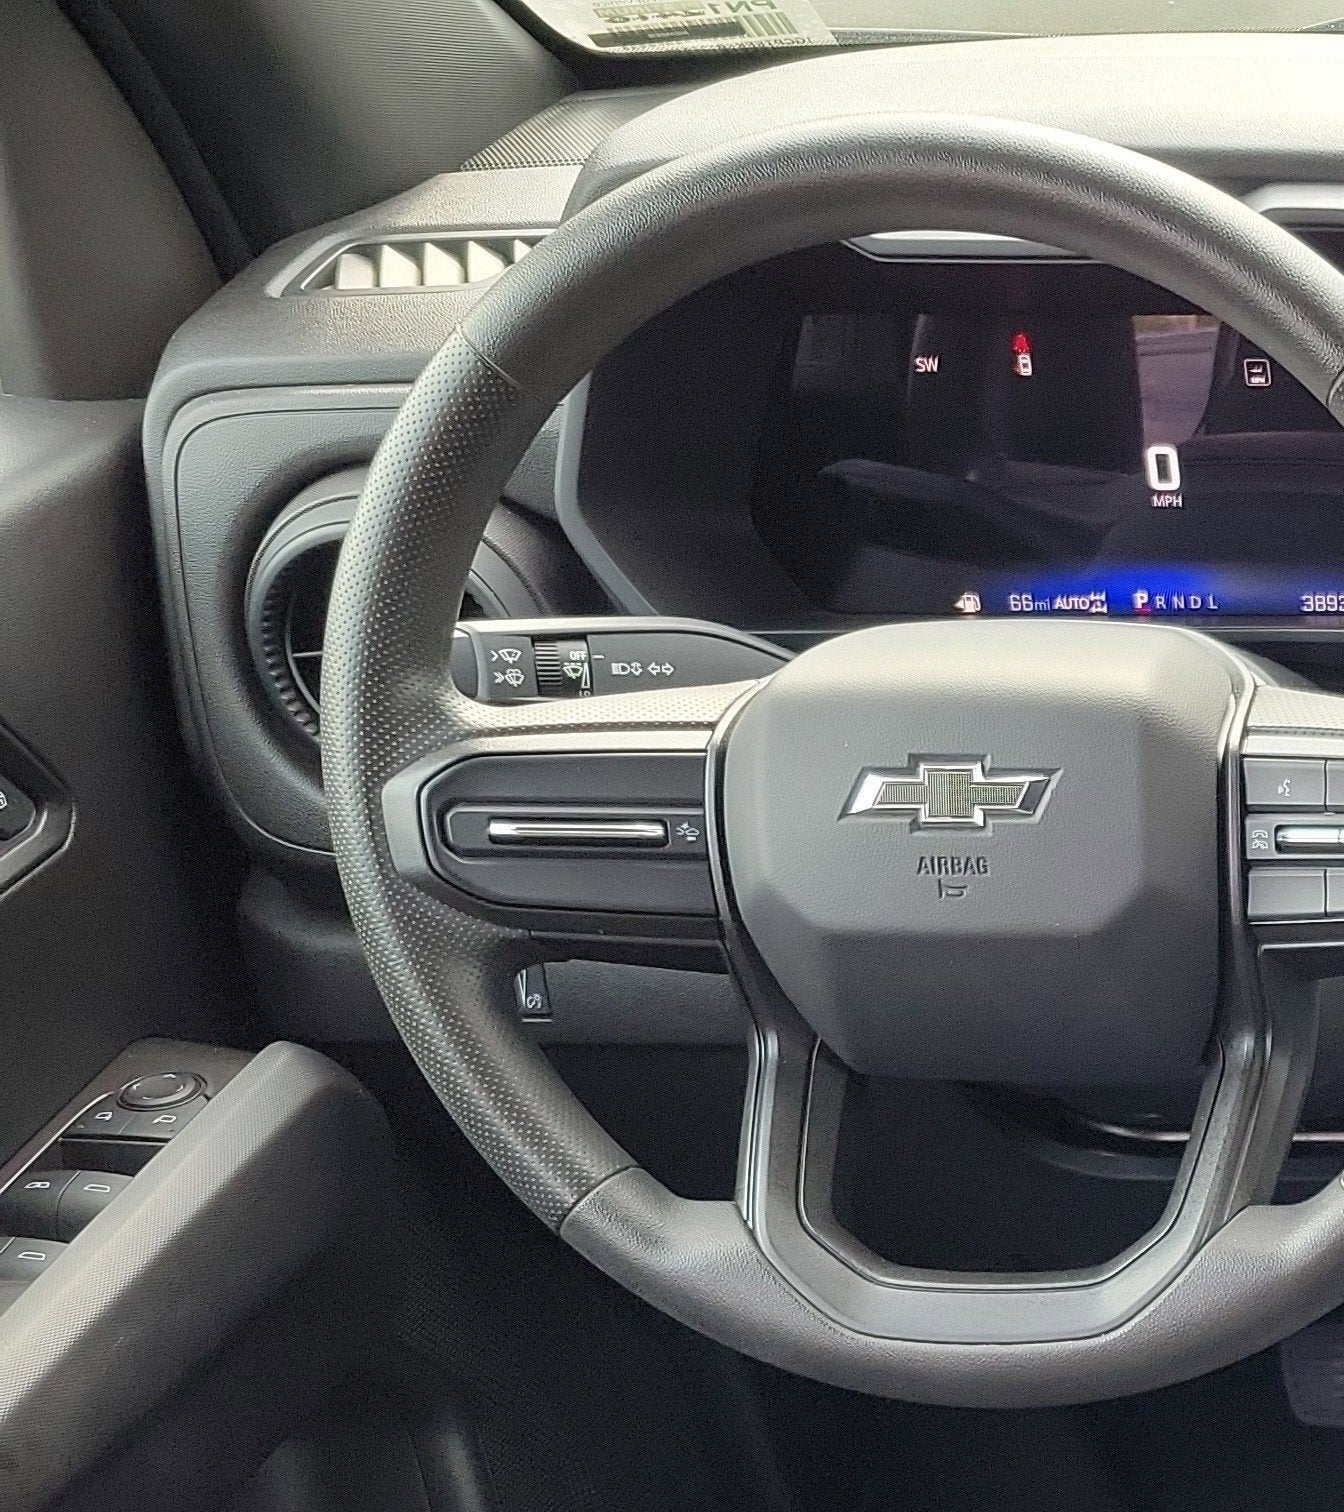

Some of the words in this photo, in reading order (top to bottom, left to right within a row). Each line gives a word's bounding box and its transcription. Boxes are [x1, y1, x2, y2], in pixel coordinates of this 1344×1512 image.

[914, 355, 939, 373] SW
[1147, 446, 1181, 491] 0
[1152, 495, 1183, 507] MPH
[1054, 594, 1090, 611] AUTO
[1134, 590, 1149, 609] P
[1155, 596, 1167, 609] R
[1173, 596, 1185, 610] N
[1190, 596, 1202, 609] D
[1207, 596, 1219, 610] L
[569, 650, 587, 661] OFF
[916, 855, 991, 876] AIRBAG
